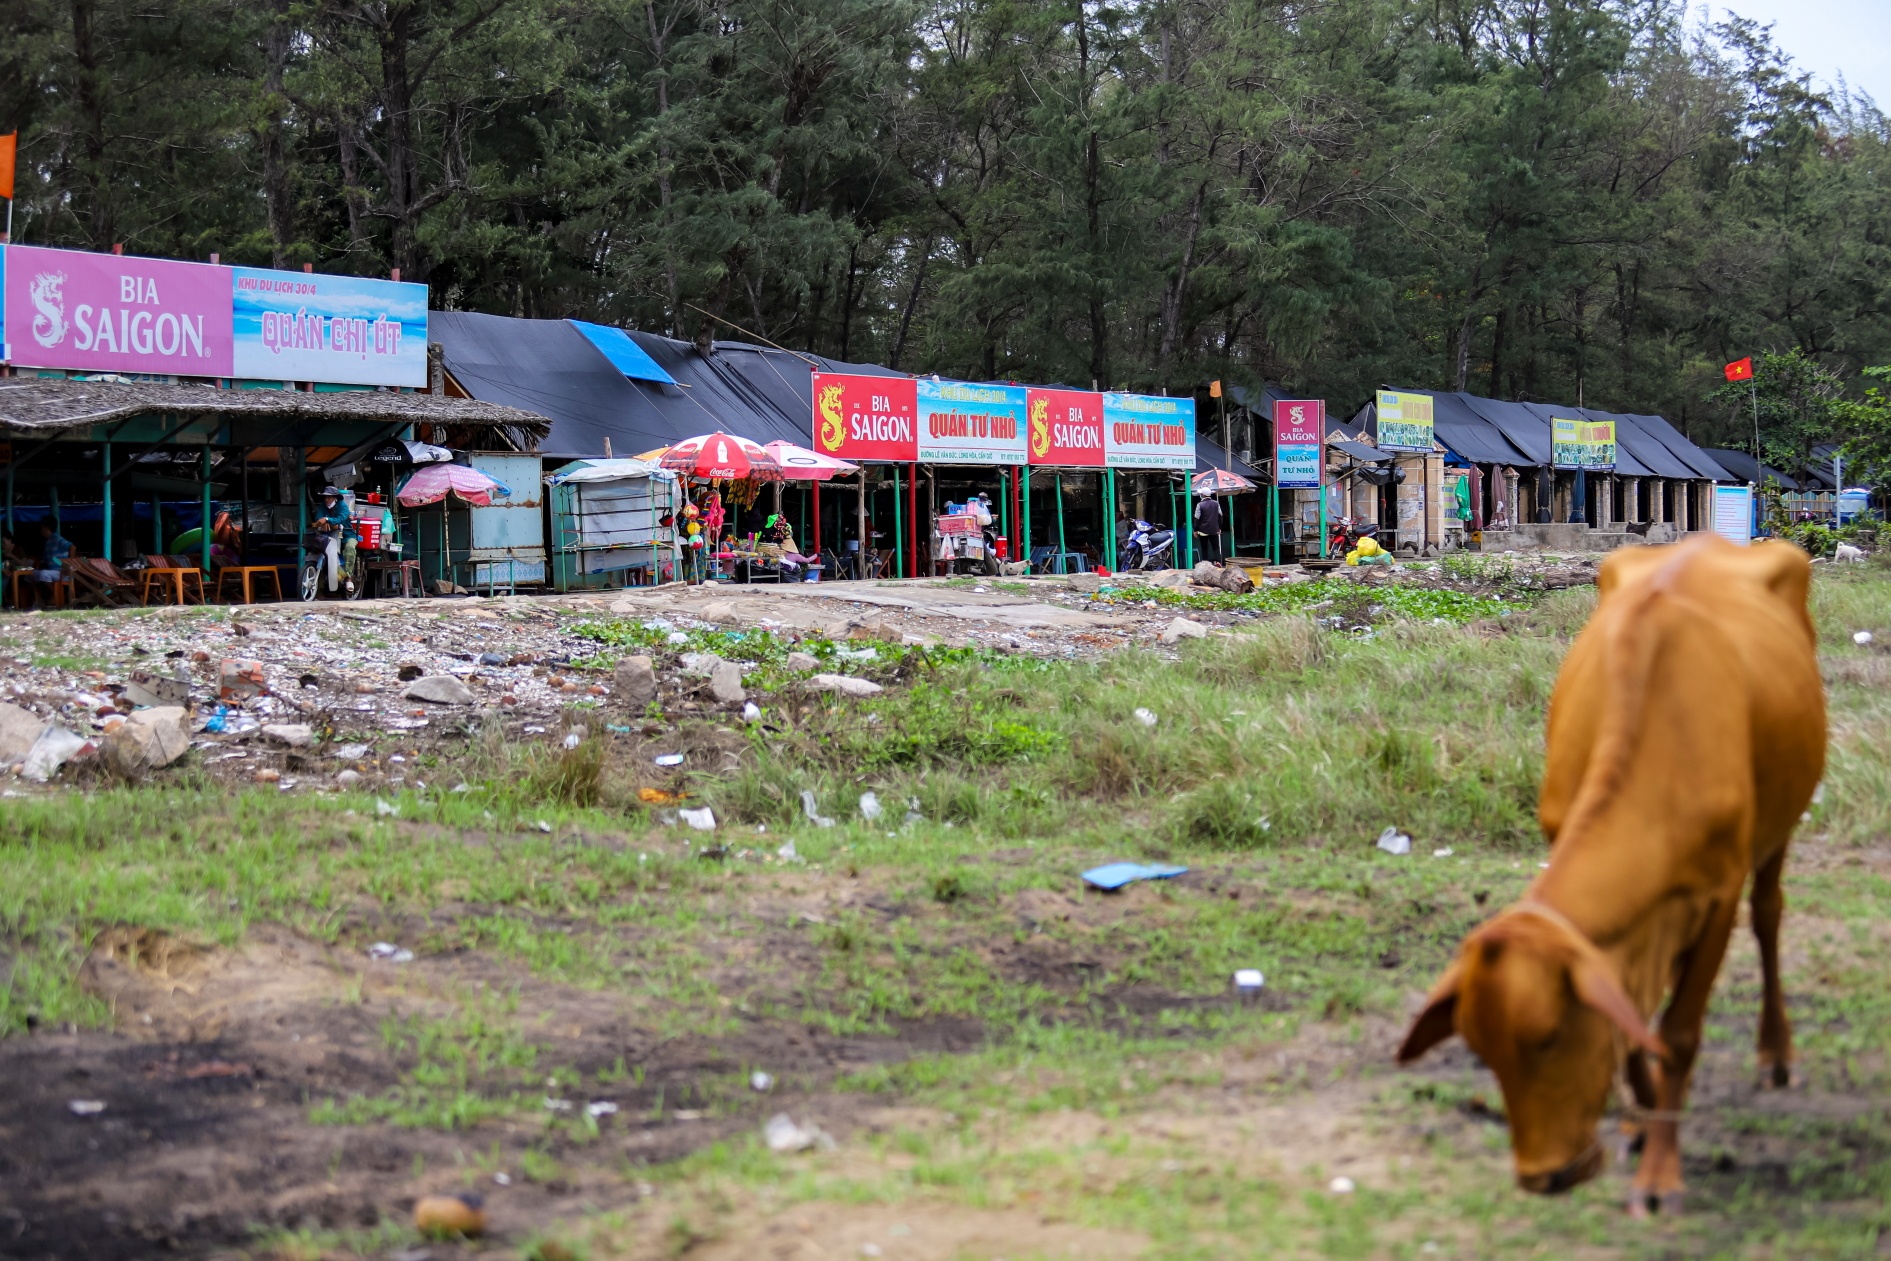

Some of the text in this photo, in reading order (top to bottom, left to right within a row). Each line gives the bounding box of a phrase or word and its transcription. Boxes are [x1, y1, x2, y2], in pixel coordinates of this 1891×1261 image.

[120, 275, 160, 305] BIA
[238, 277, 317, 296] KHU DU LỊCH 30/4
[74, 303, 204, 357] SAIGON
[262, 306, 401, 360] QUÁN CHỊ ÚT
[872, 395, 891, 412] BIA
[1069, 407, 1083, 422] BIA
[851, 413, 910, 442] SAIGON
[929, 408, 1017, 440] QUÁN TƯ NHỎ
[1054, 423, 1099, 449] SAIGON
[1113, 418, 1186, 446] QUÁN TƯ NHỎ
[1280, 432, 1316, 441] SAIGON
